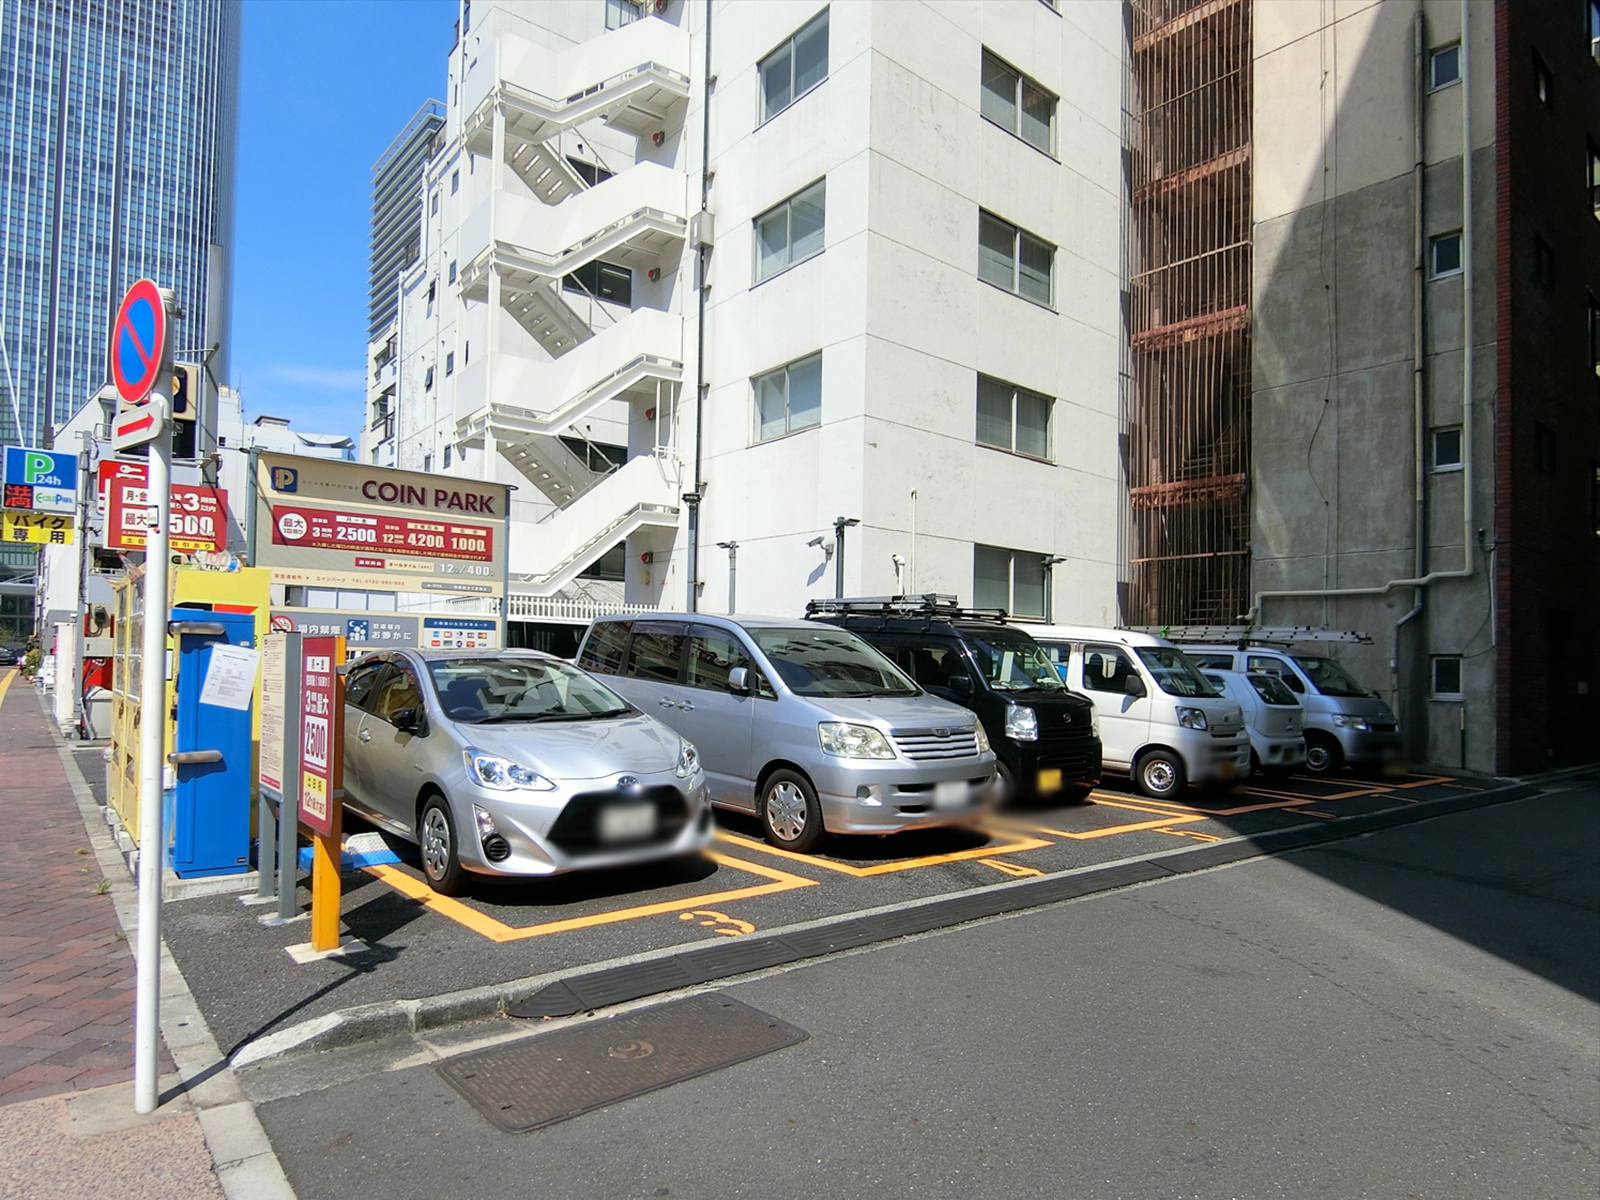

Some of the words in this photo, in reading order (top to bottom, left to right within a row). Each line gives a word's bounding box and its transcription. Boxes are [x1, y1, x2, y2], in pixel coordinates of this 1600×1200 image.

[25, 452, 55, 484] P
[37, 475, 62, 486] 24h
[183, 492, 200, 512] 3
[362, 480, 426, 506] COIN
[434, 488, 495, 514] PARK
[13, 514, 66, 530] バイク
[124, 512, 148, 526] 最大
[283, 518, 304, 528] 最大
[13, 528, 65, 544] 専用
[312, 527, 321, 538] 3
[336, 526, 377, 543] 2,500
[382, 533, 394, 544] 12
[407, 532, 445, 549] 4,200
[450, 537, 487, 552] 1,000
[204, 562, 220, 571] YEN
[299, 624, 341, 635] 場内禁煙
[371, 631, 412, 640] お静かに
[316, 692, 329, 715] 最大
[1153, 827, 1222, 842] 5
[977, 859, 1046, 877] 4
[678, 910, 756, 936] 3
